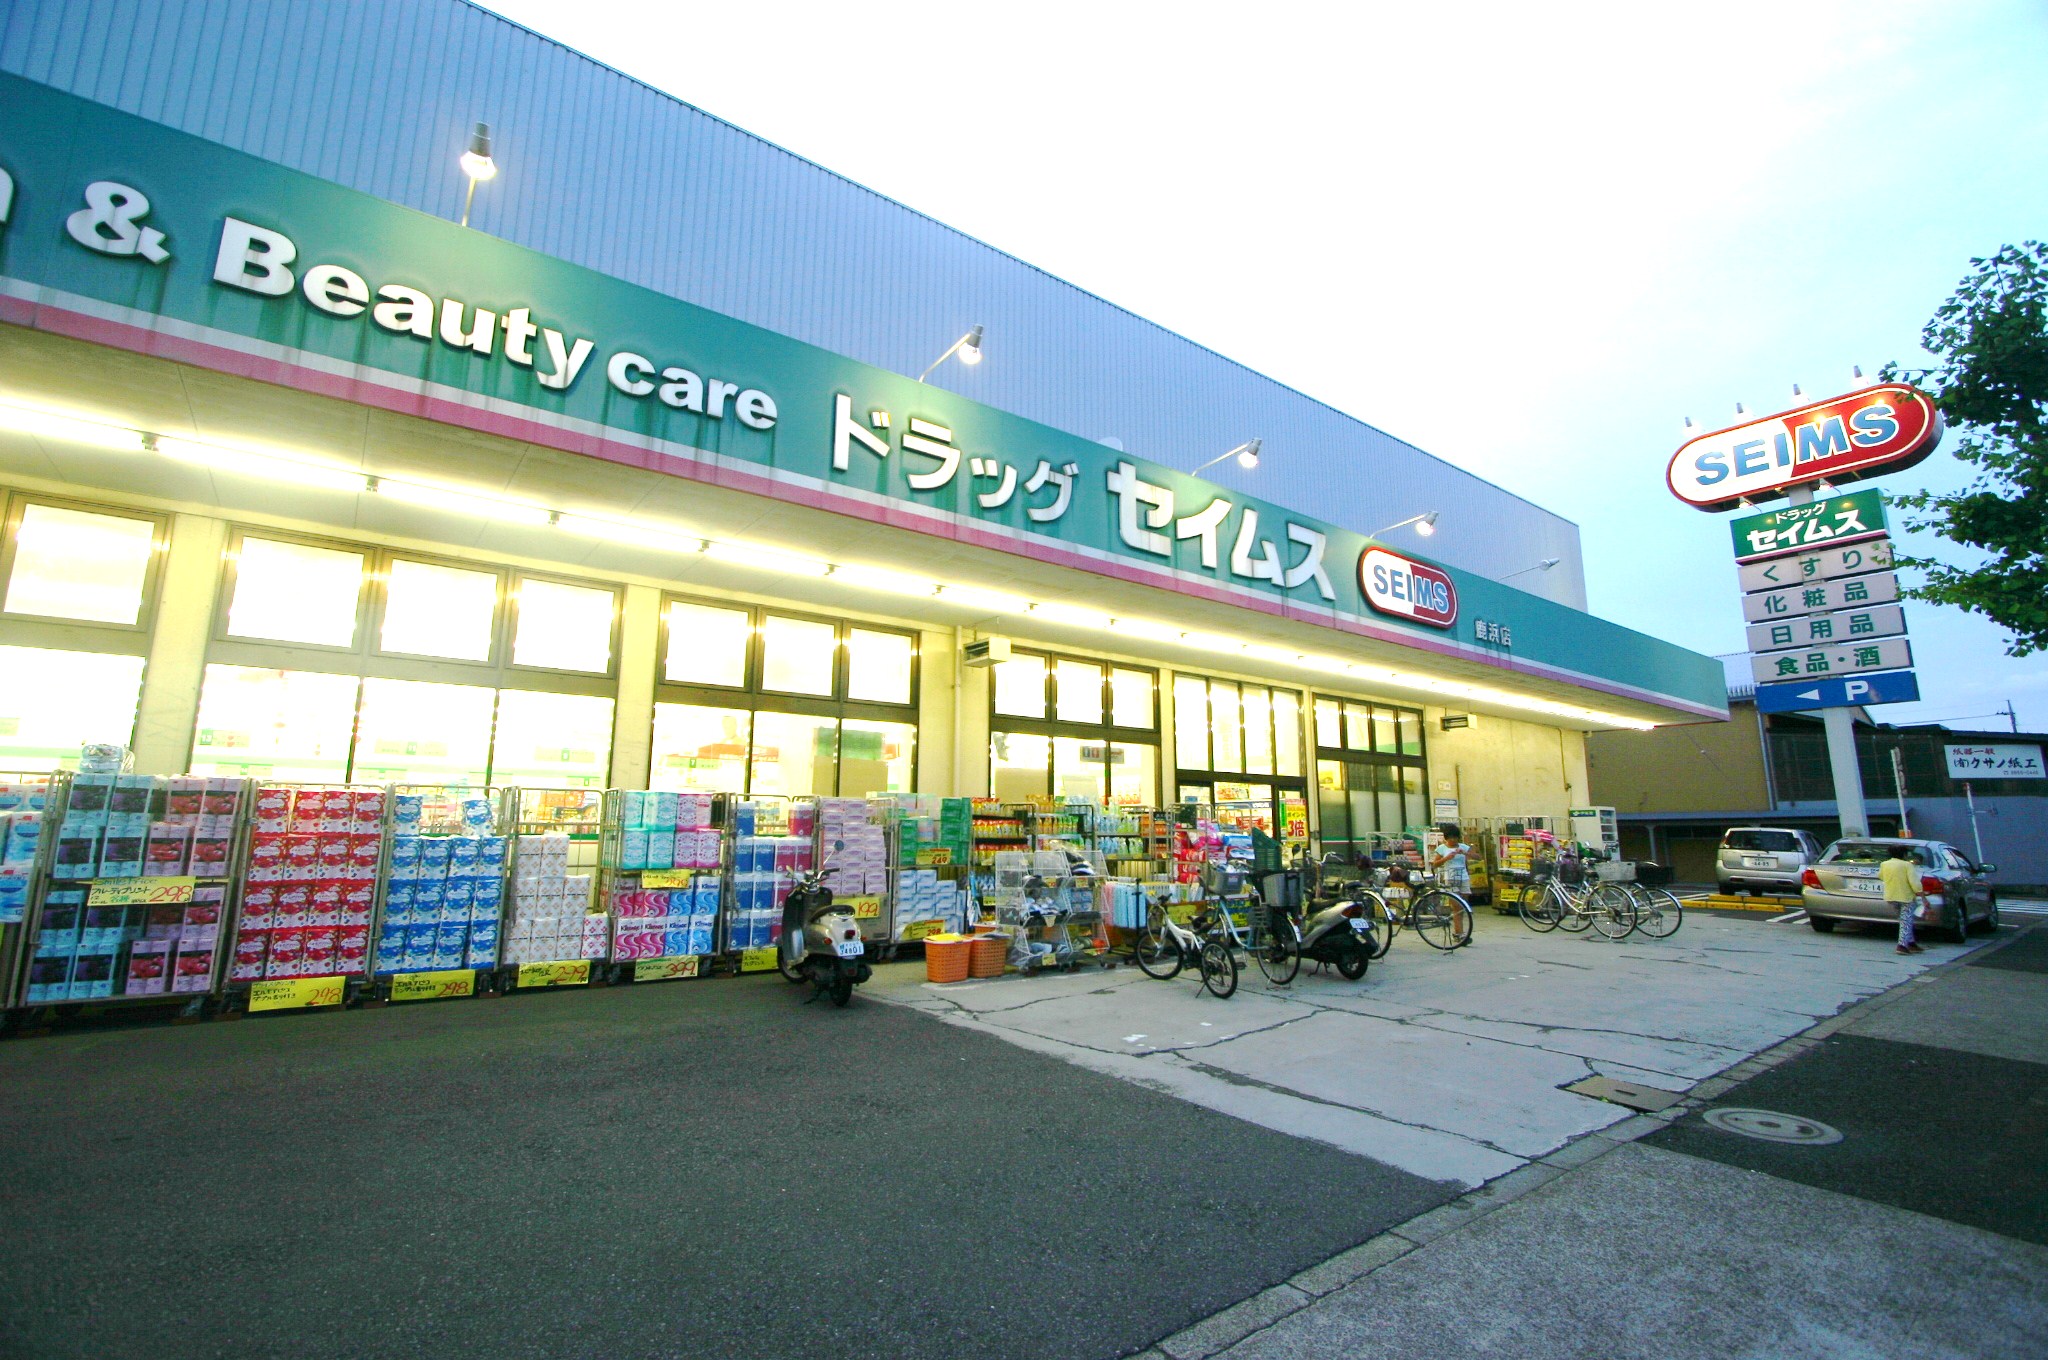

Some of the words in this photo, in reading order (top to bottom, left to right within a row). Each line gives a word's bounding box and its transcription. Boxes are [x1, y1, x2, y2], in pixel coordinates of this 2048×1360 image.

[67, 181, 170, 264] &
[213, 216, 593, 389] Beauty
[608, 351, 778, 430] care
[1695, 404, 1898, 486] SEIMS
[833, 393, 1078, 521] ドラッグ
[1107, 461, 1335, 600] セイムス
[1775, 502, 1827, 523] ドラッグ
[1746, 508, 1869, 553] セイムス
[1763, 549, 1862, 582] くすり
[1373, 564, 1449, 614] SEIMS
[1764, 581, 1869, 614] 化粧品
[1475, 619, 1512, 647] 鹿浜店
[1771, 614, 1875, 645] 日用品
[1775, 646, 1880, 676] 食品・酒
[1845, 680, 1869, 701] P
[149, 885, 193, 903] 298
[858, 901, 878, 917] 199
[662, 960, 696, 978] 399
[306, 987, 343, 1005] 298
[438, 981, 470, 996] 298
